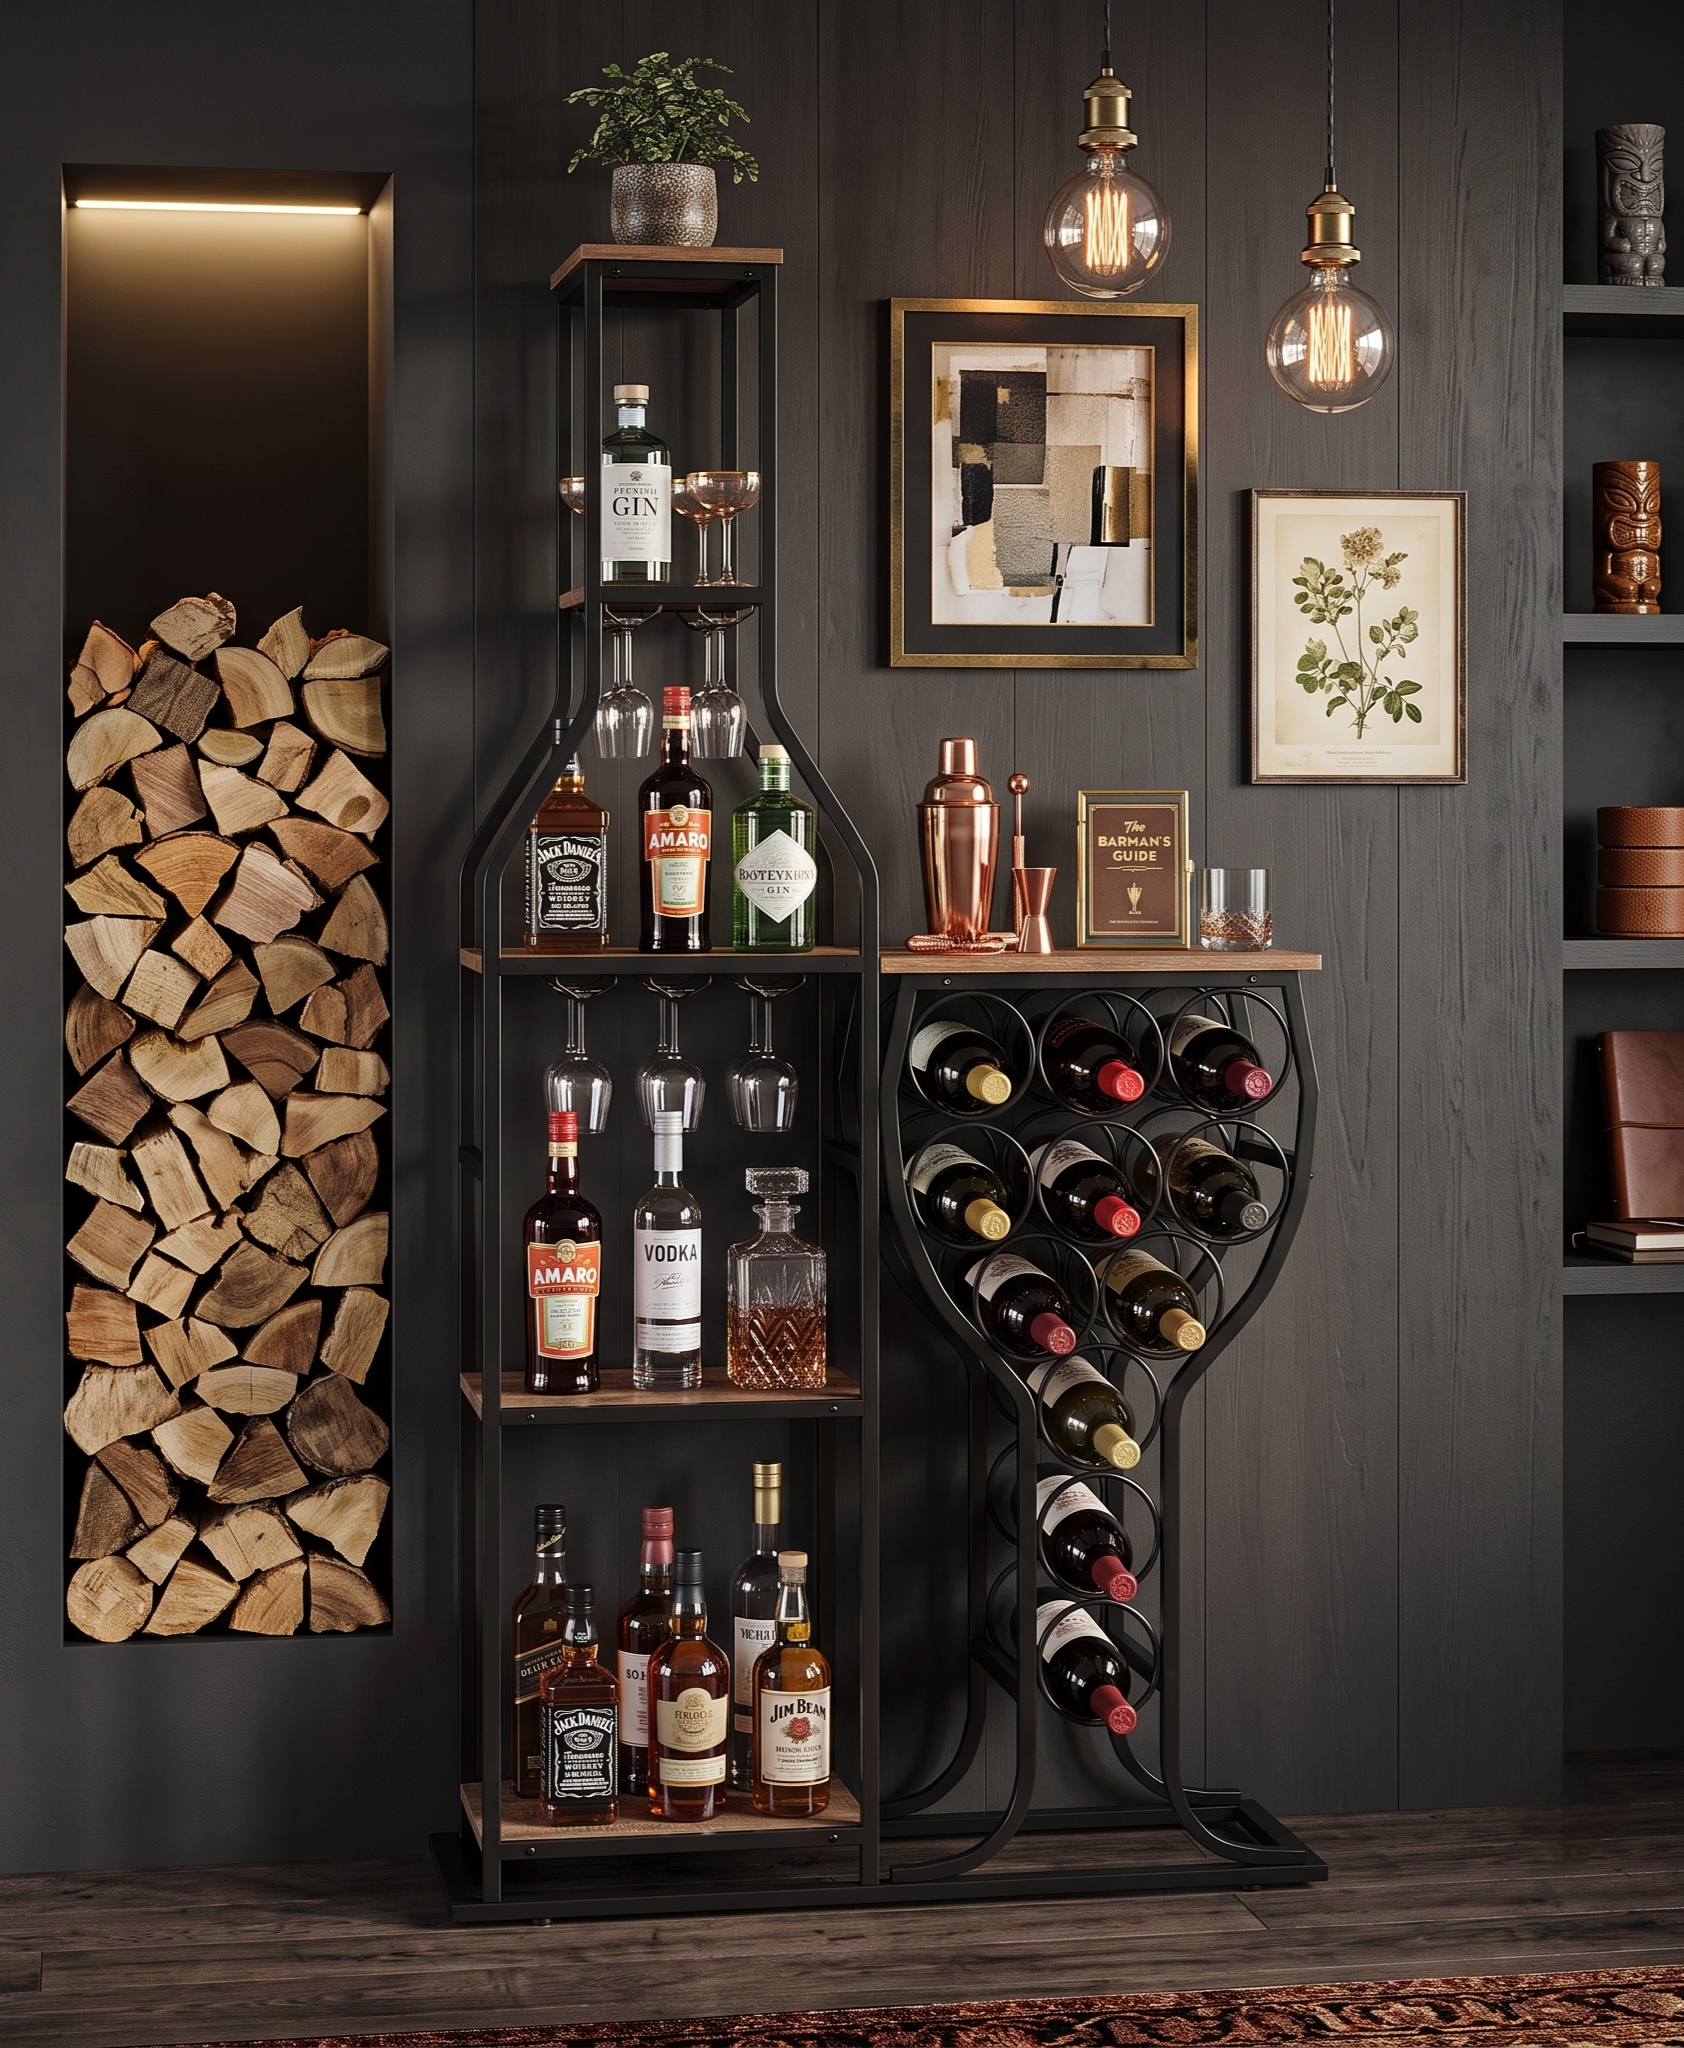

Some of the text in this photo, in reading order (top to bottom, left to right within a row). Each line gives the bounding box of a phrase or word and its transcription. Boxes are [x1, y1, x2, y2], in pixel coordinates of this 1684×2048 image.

[612, 496, 659, 517] GIN
[1124, 820, 1147, 833] The
[649, 831, 709, 850] AMARO
[1098, 836, 1172, 847] BARMAN'S
[537, 844, 563, 865] JACK
[1112, 850, 1157, 862] GUIDE
[767, 886, 790, 894] GIN
[644, 1243, 698, 1263] VODKA
[534, 1266, 598, 1286] AMARO
[770, 1698, 827, 1724] JIM BEAM
[553, 1715, 579, 1736] JACK
